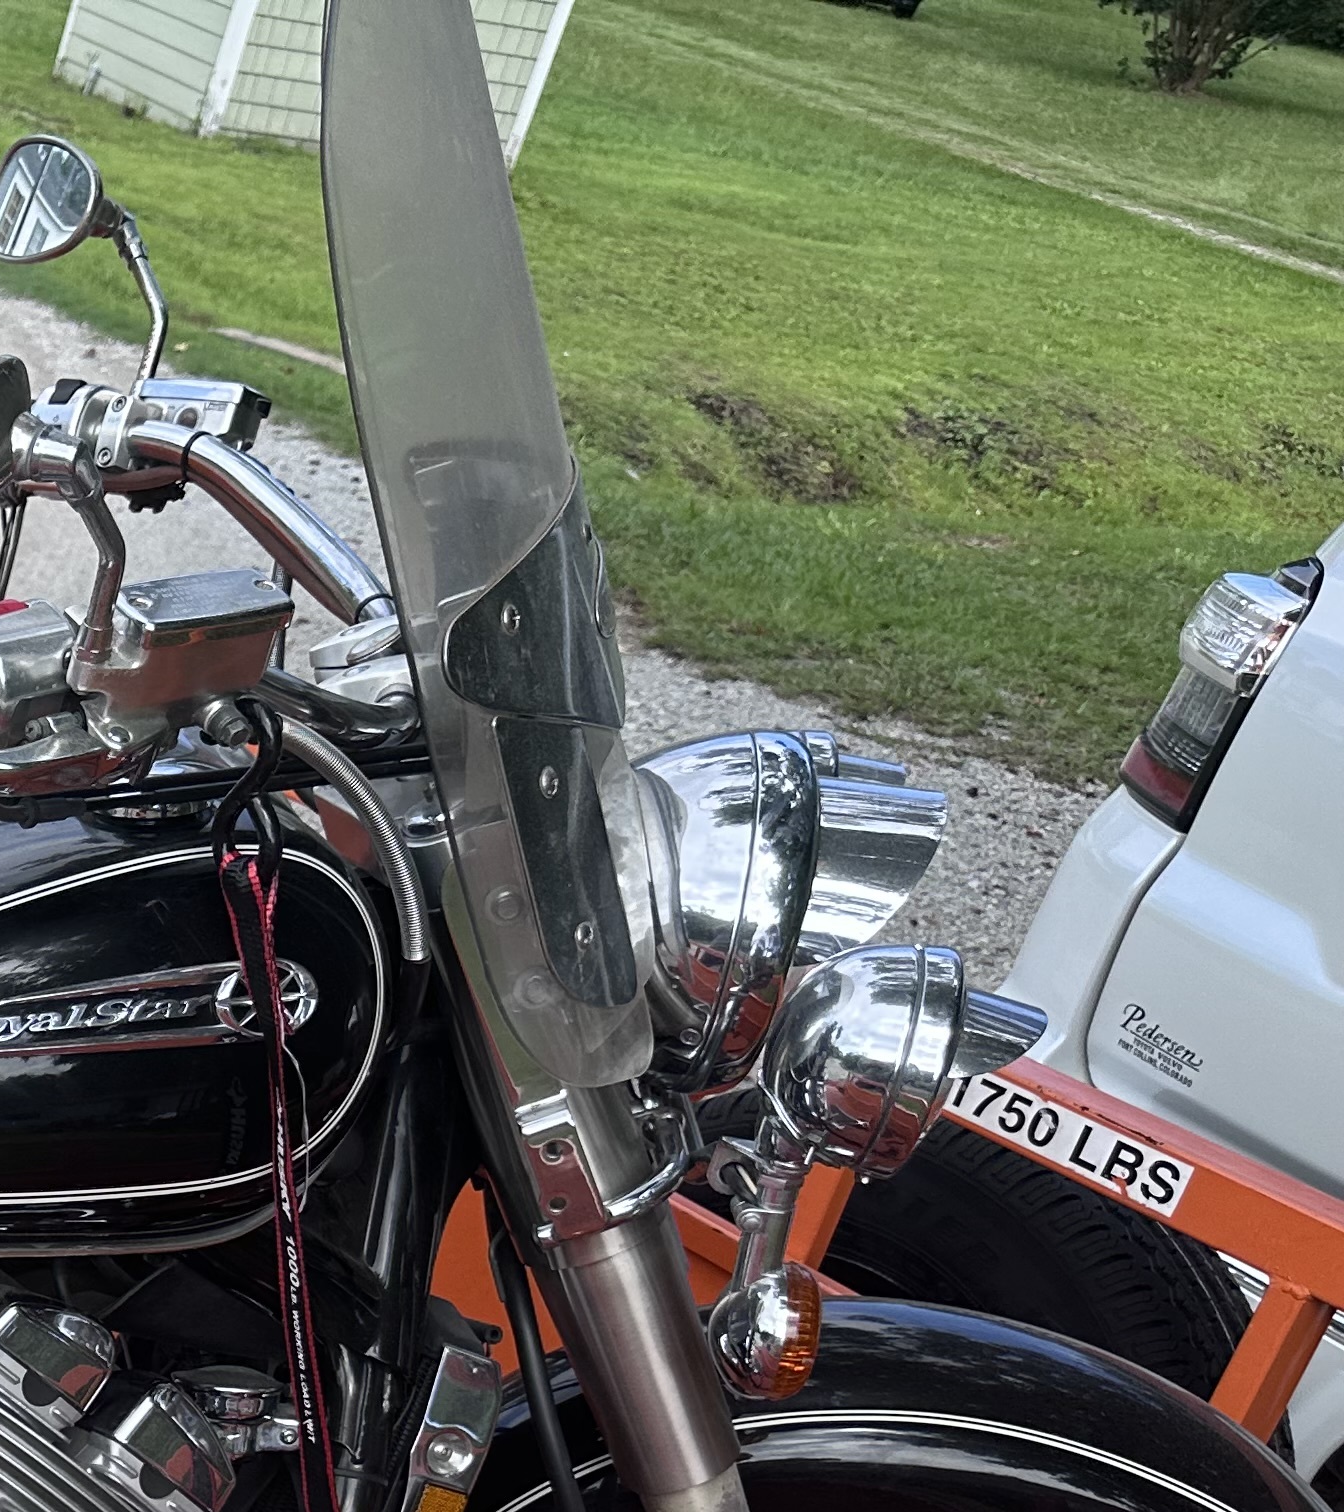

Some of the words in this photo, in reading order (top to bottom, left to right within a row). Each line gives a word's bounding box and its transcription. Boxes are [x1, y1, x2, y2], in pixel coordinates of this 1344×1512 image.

[1119, 1002, 1204, 1068] Pedersen
[953, 1076, 1060, 1147] 1750
[1068, 1125, 1181, 1204] LBS
[292, 1309, 305, 1370] WORKING
[299, 1373, 311, 1409] LOAD
